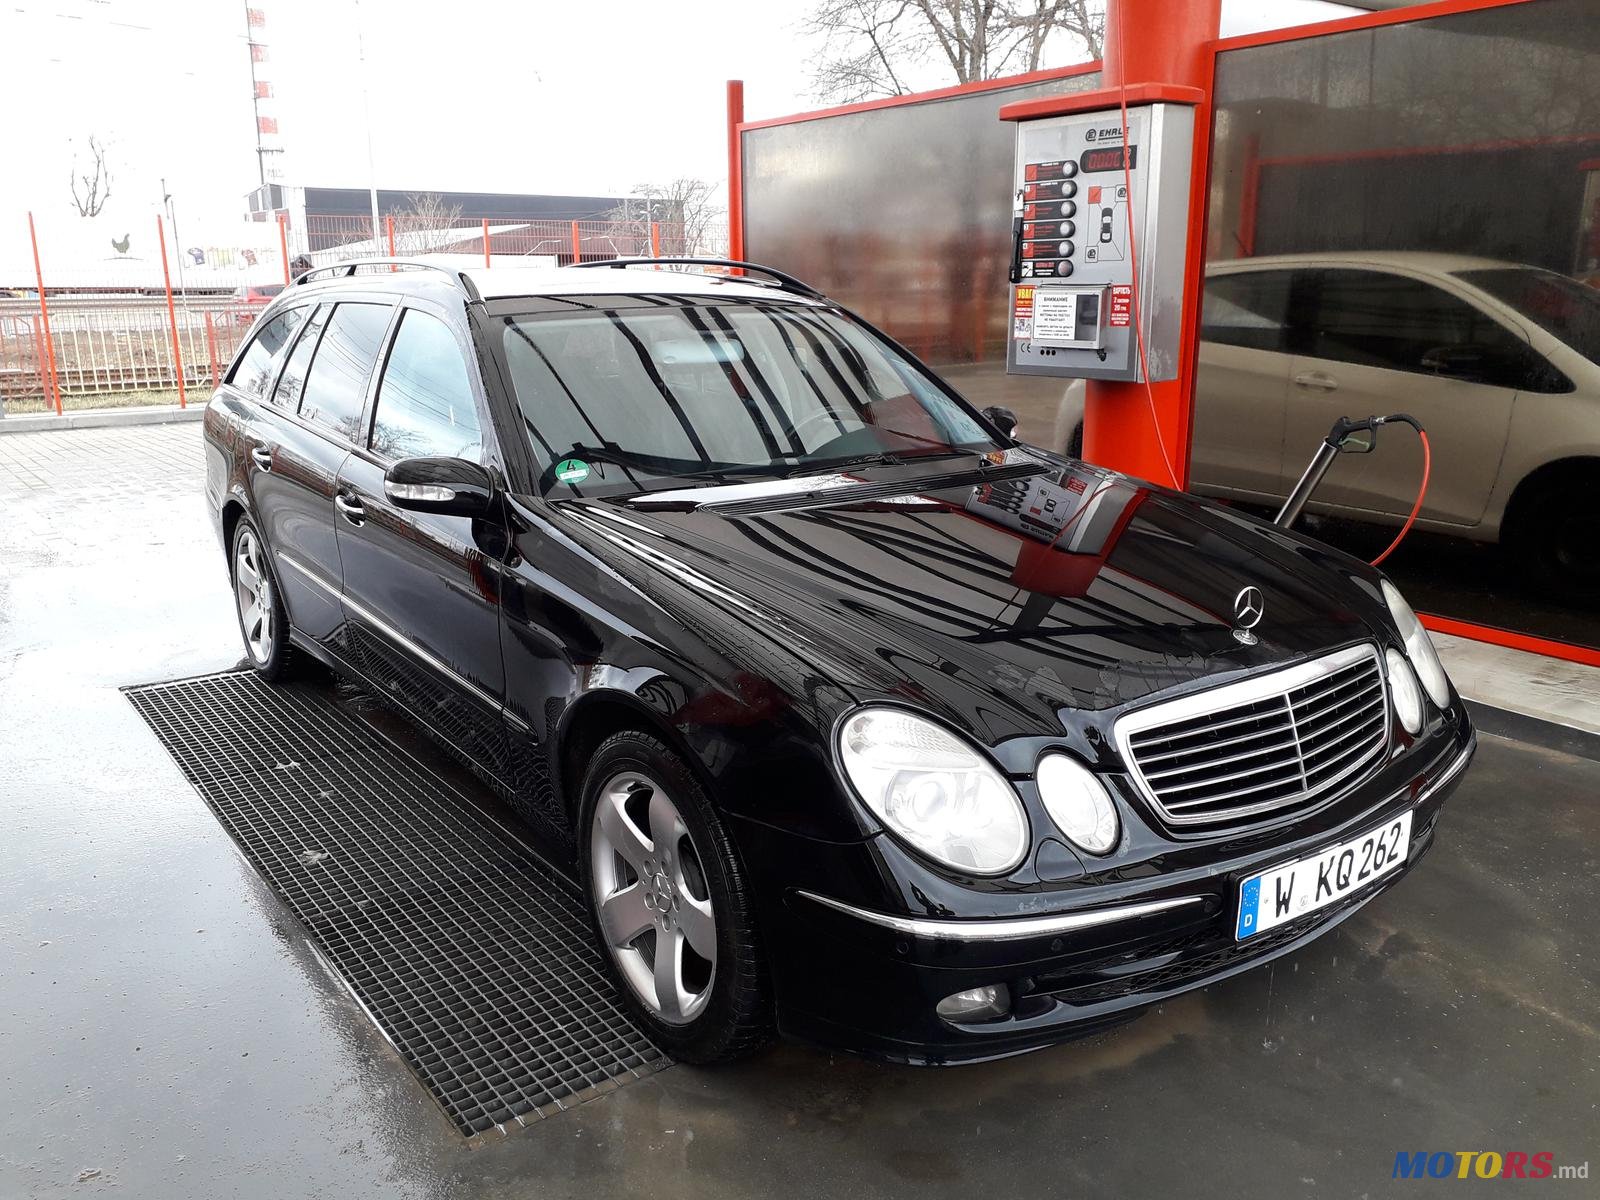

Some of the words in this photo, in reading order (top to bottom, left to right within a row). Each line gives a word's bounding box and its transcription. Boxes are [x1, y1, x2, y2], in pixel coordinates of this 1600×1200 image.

[567, 460, 576, 471] 4
[1275, 871, 1295, 919] W
[1244, 914, 1253, 928] D
